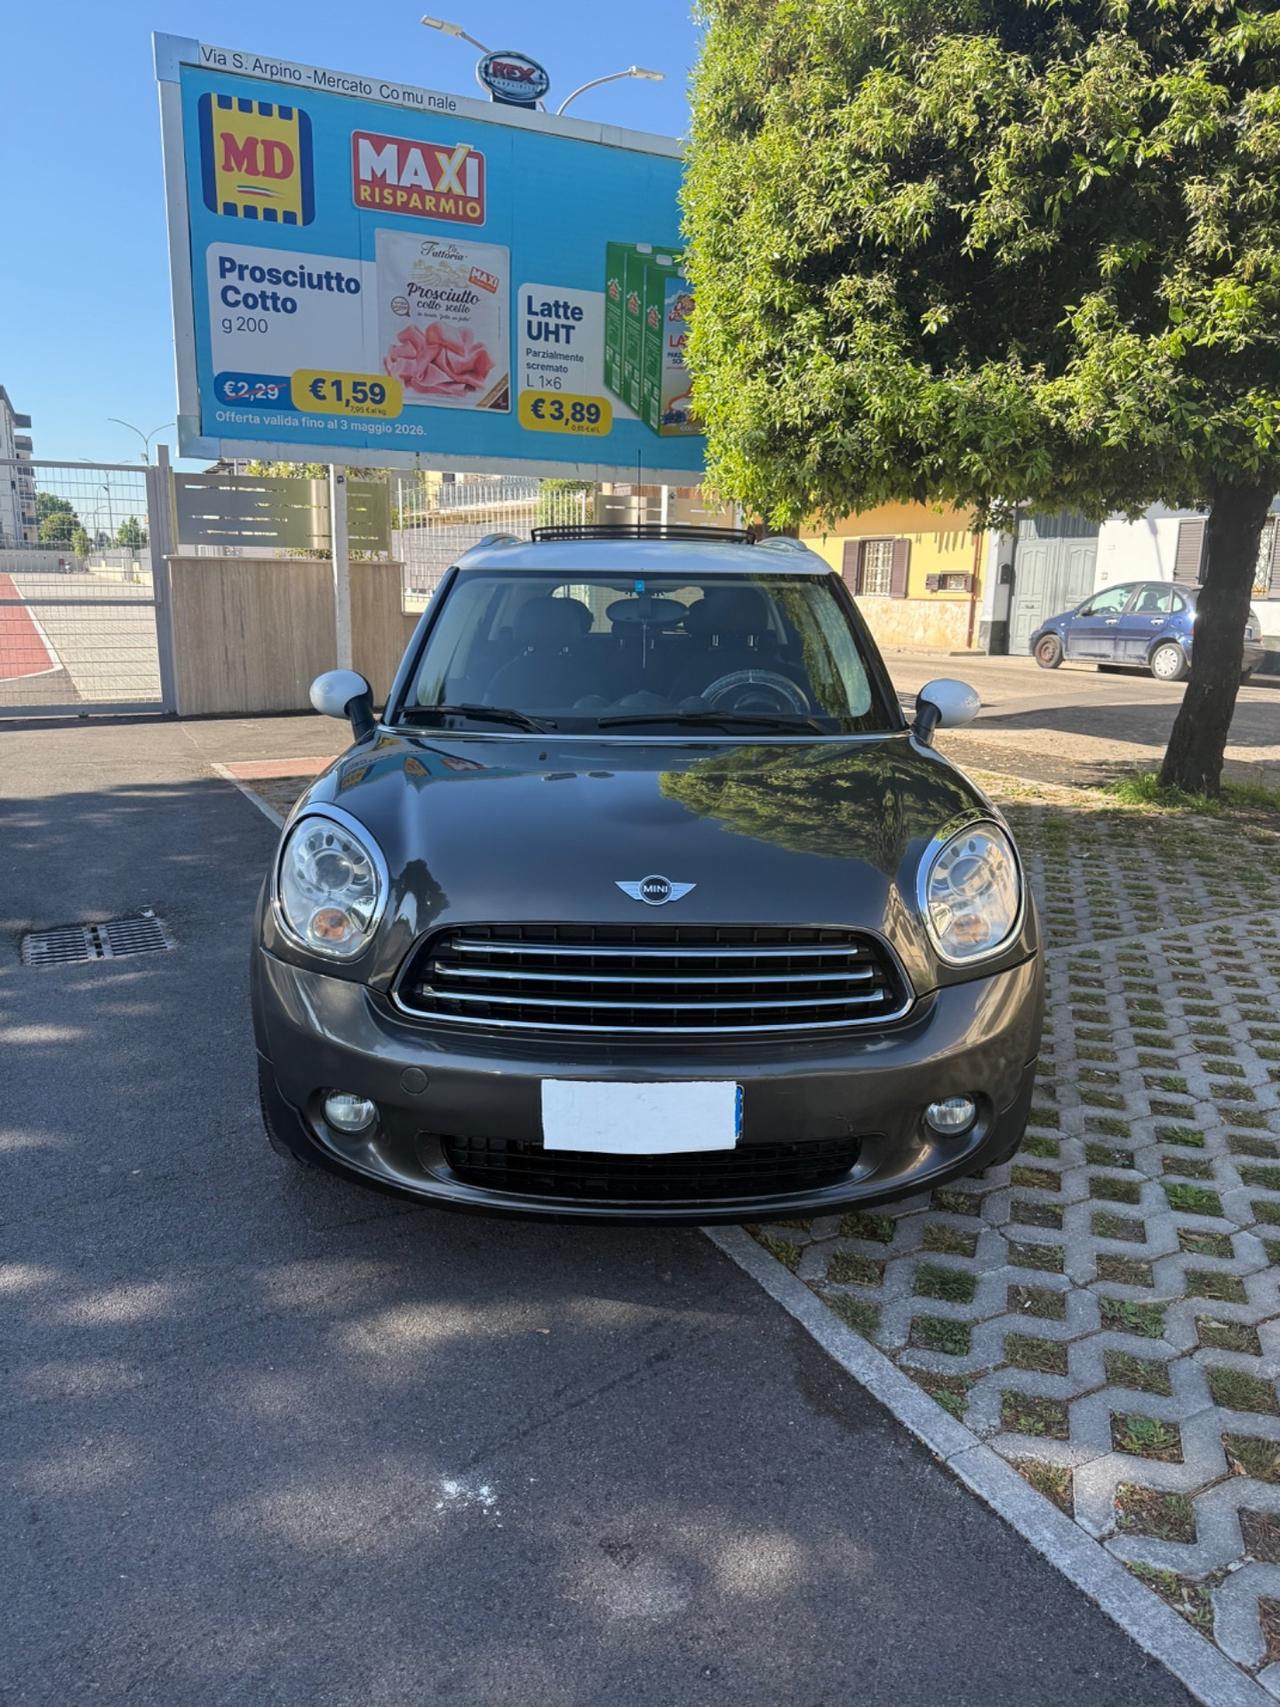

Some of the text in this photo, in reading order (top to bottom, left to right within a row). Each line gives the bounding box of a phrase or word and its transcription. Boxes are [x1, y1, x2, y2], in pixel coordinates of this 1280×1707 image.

[201, 46, 227, 65] Via
[232, 54, 249, 71] S.
[253, 58, 302, 81] Arpino
[220, 132, 294, 180] MD
[358, 139, 479, 198] MAXI
[359, 184, 481, 218] RISPARMIO
[218, 256, 361, 294] Prosciutto
[221, 285, 297, 314] Cotto
[407, 282, 480, 305] Prosciutto
[527, 295, 584, 322] Latte
[221, 316, 268, 333] g 200
[527, 320, 575, 344] UHT
[526, 348, 584, 363] Parzialmente
[526, 363, 569, 374] scremato
[526, 374, 534, 388] L
[216, 411, 427, 436] Offerta valida fino al 3 maggio 2026.
[643, 885, 668, 893] MINI
